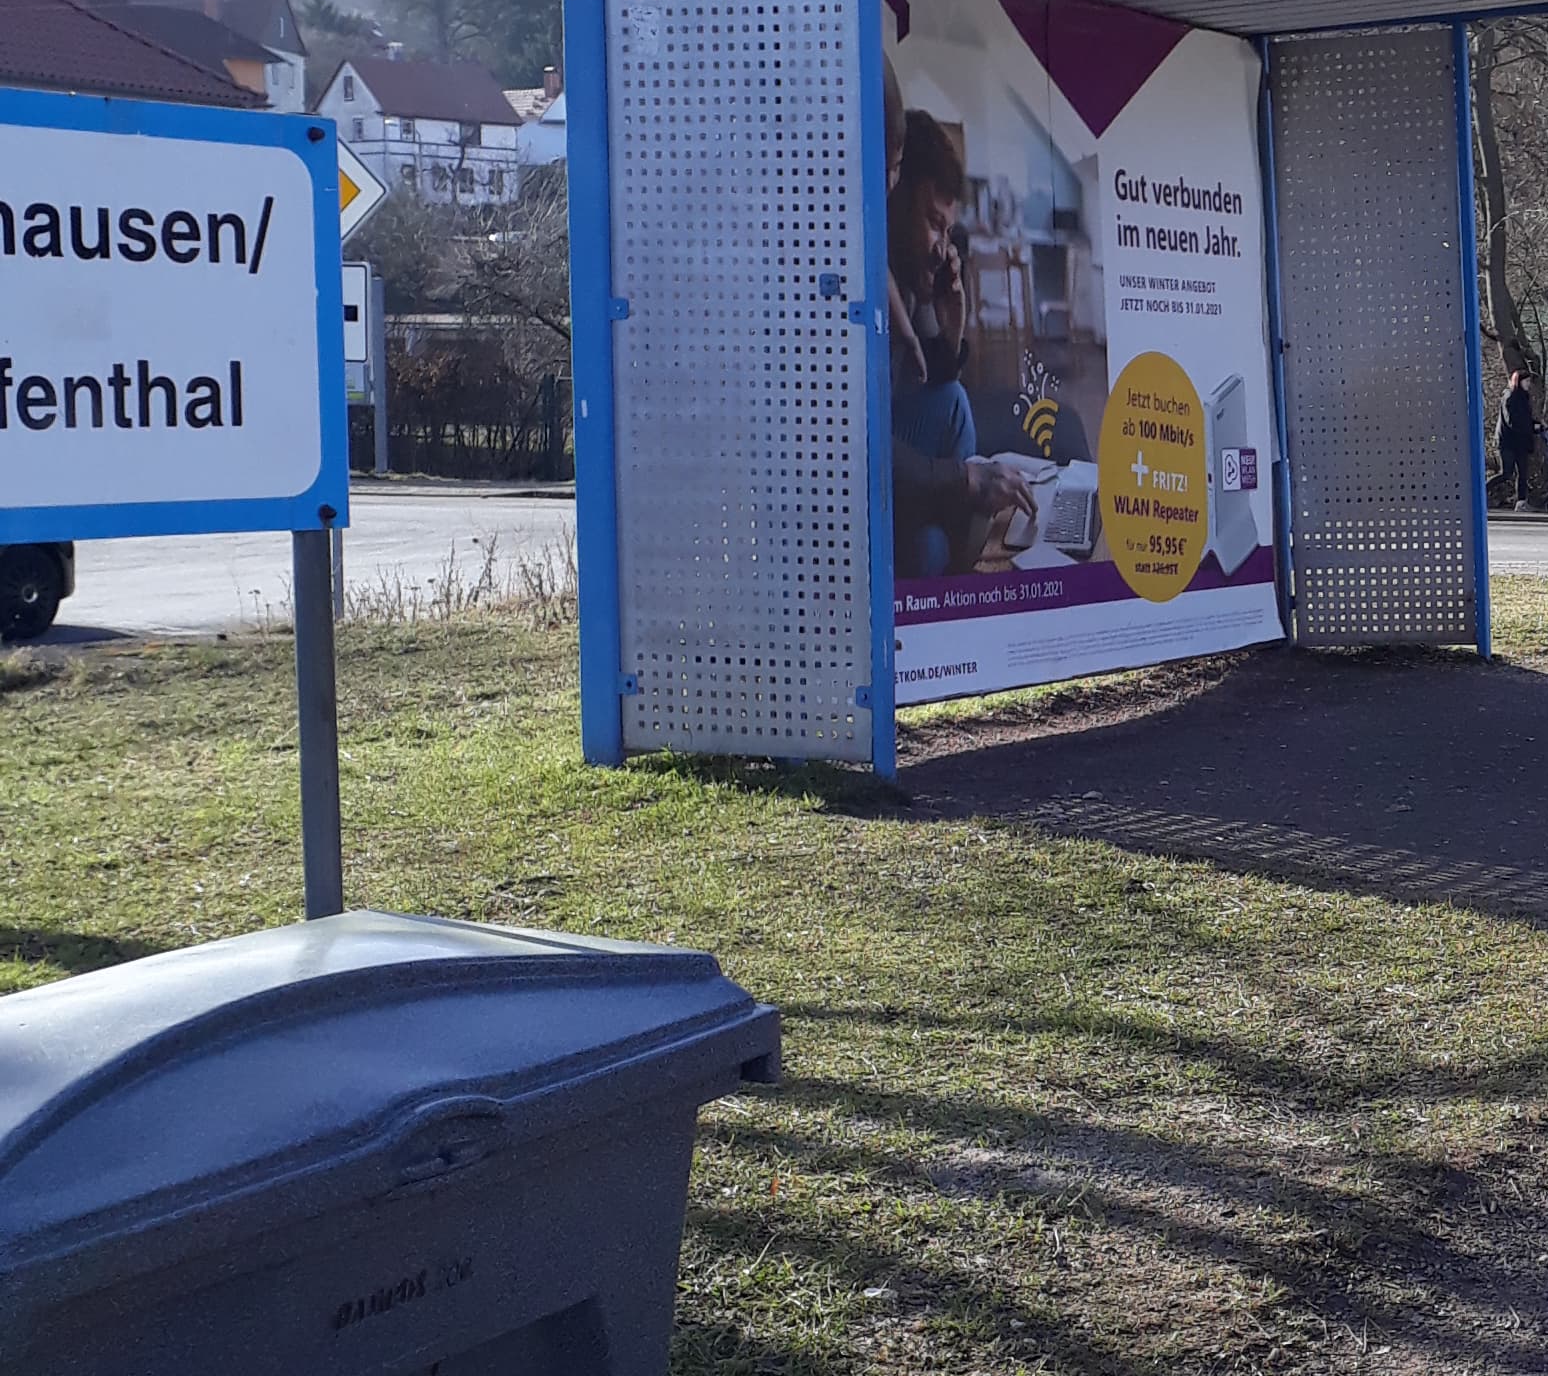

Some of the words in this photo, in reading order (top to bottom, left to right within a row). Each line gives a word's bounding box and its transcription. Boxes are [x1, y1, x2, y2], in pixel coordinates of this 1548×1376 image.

[1114, 169, 1147, 204] Gut
[1152, 177, 1242, 215] verbunden
[1116, 215, 1140, 248] im
[1146, 227, 1199, 254] neuen
[1203, 225, 1241, 258] Jahr.
[1119, 275, 1147, 289] UNSER
[1149, 278, 1180, 291] WINTER
[1181, 281, 1216, 293] ANGEBOT
[1120, 298, 1144, 312] JETZT
[1146, 300, 1170, 313] NOCH
[1171, 302, 1184, 314] BIS
[1185, 302, 1222, 315] 31.01.2021
[1126, 388, 1151, 410] Jetzt
[1153, 394, 1191, 416] buchen
[1122, 419, 1135, 436] ab
[1139, 421, 1157, 440] 100
[1159, 423, 1195, 448] Mbit/s
[1152, 471, 1188, 493] FRITZ!
[1114, 495, 1150, 516] WLAN
[1152, 500, 1199, 525] Repeater
[906, 594, 941, 613] Raum.
[943, 590, 977, 609] Aktion
[978, 585, 1002, 604] noch
[1003, 583, 1018, 602] bis
[1019, 580, 1064, 601] 31.01.2021
